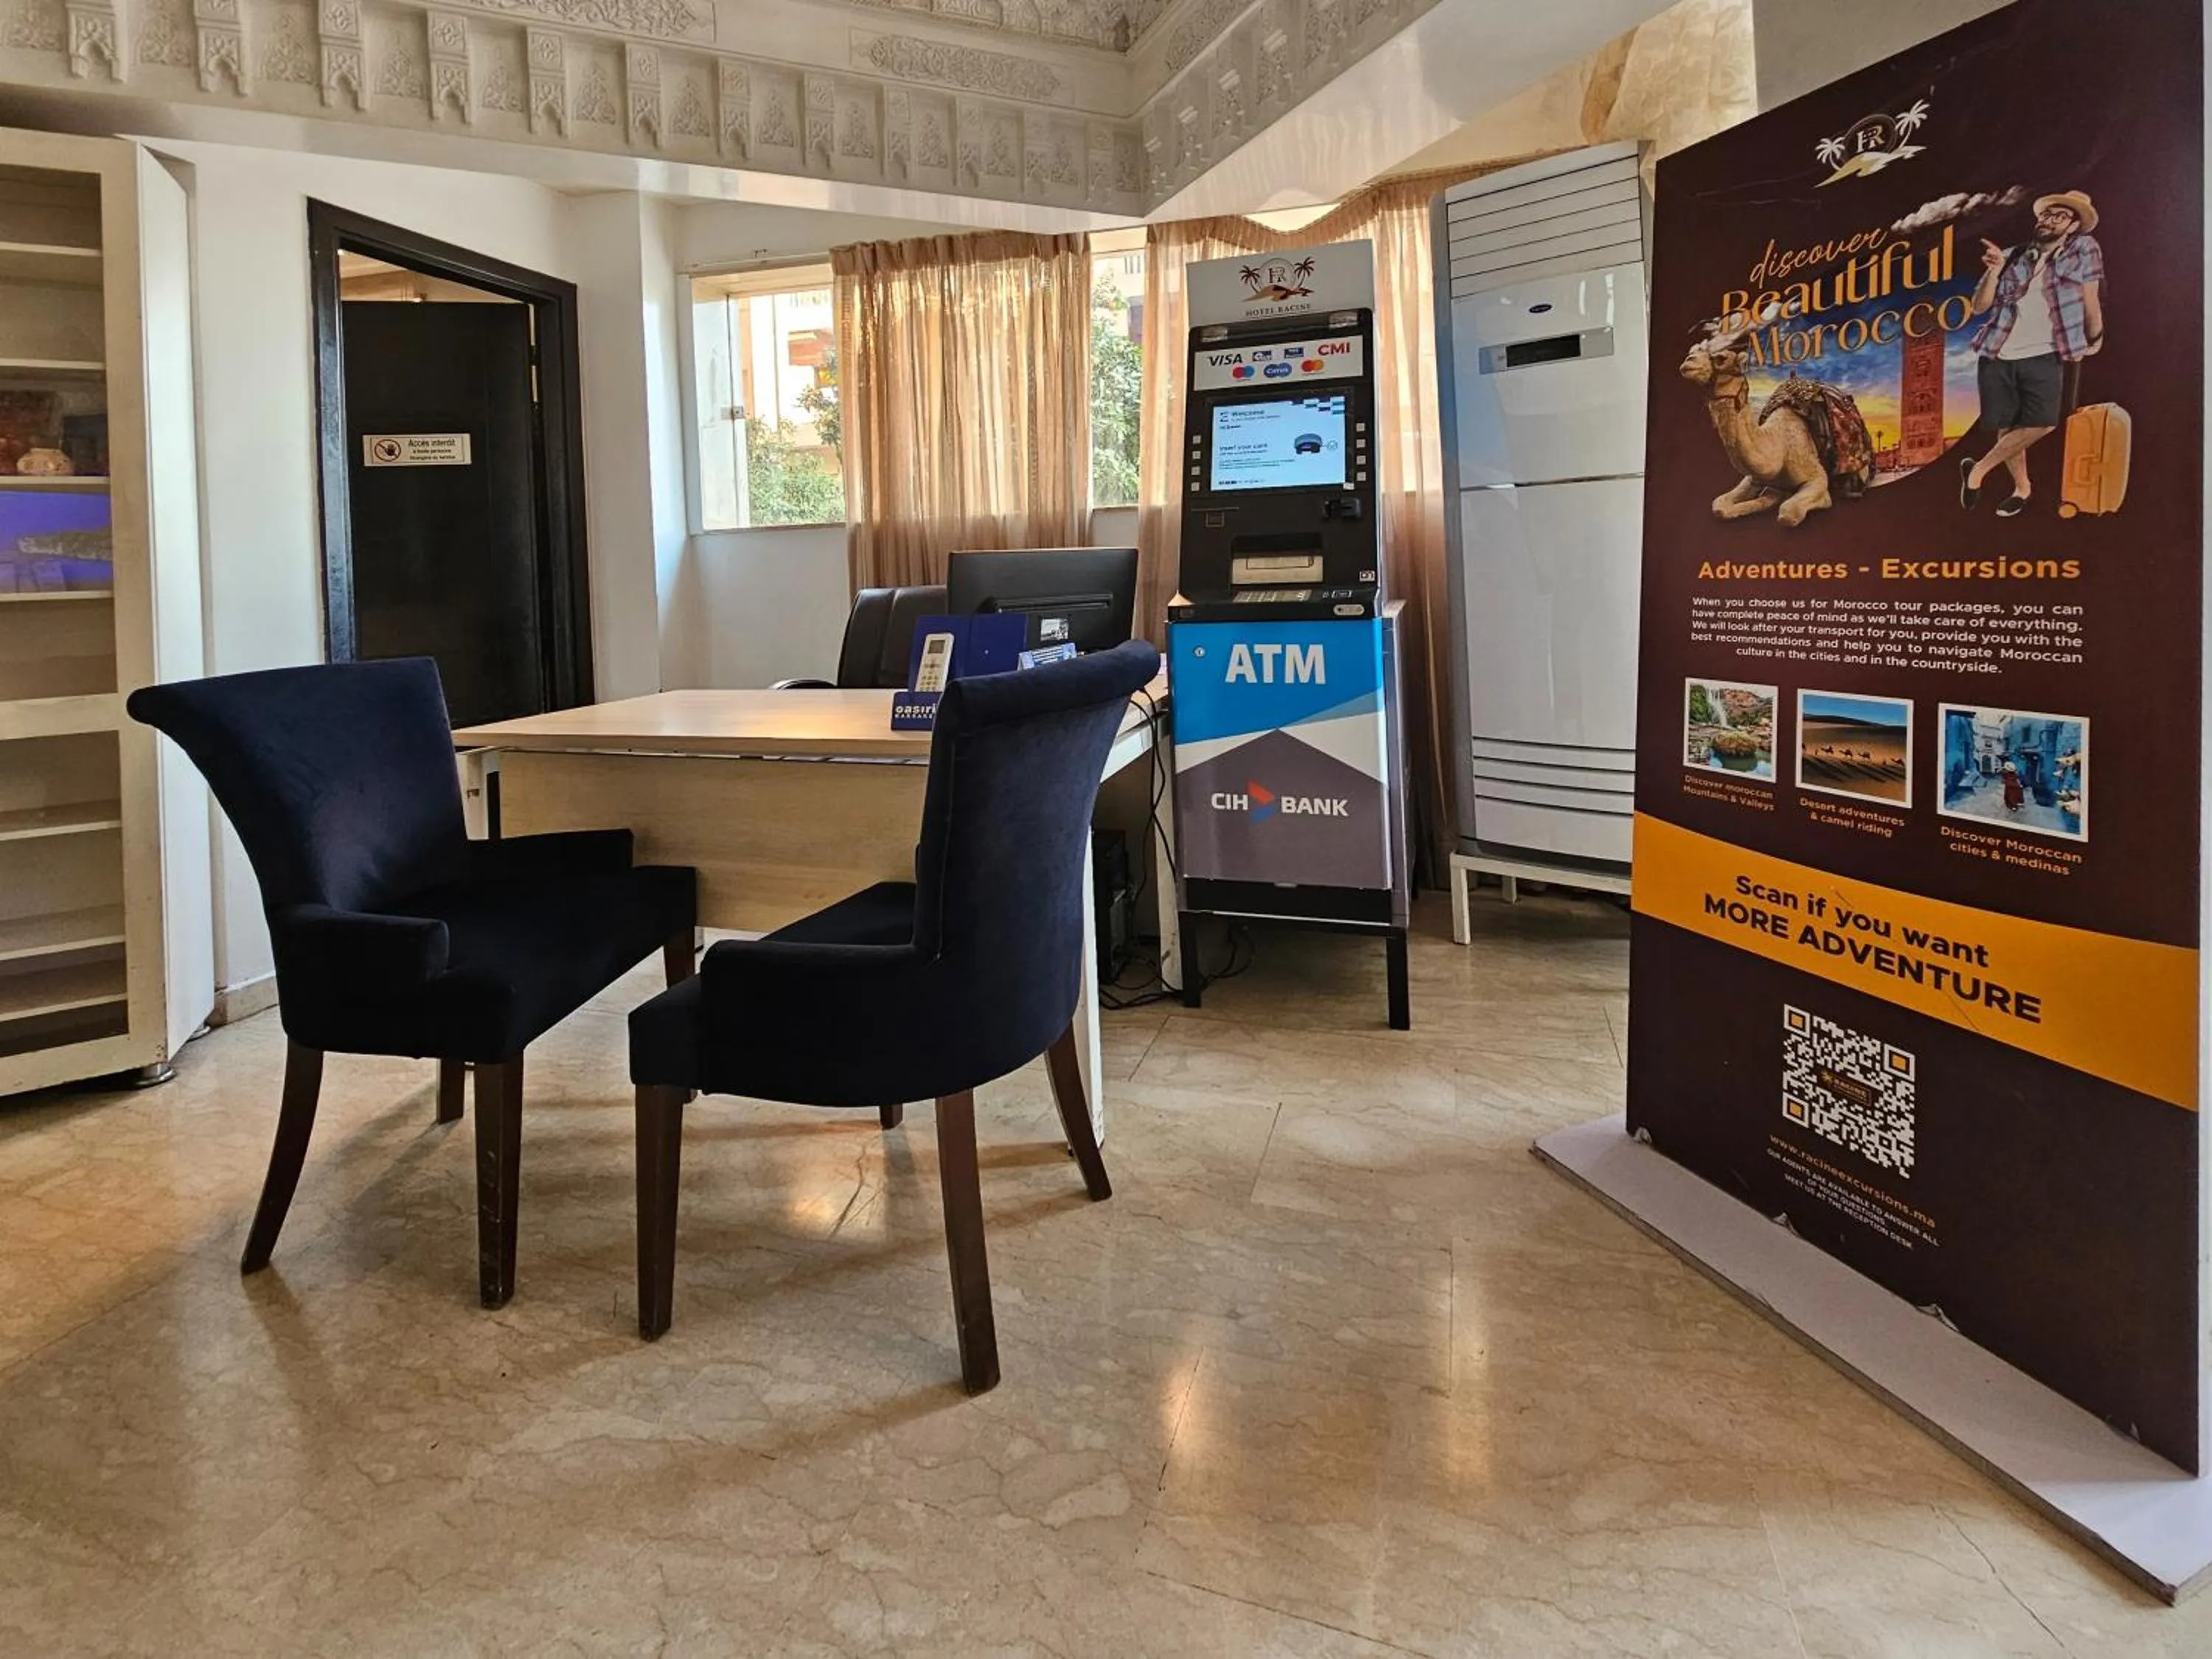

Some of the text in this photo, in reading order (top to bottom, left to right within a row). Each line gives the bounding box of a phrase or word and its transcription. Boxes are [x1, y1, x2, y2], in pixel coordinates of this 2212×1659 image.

[1749, 228, 1887, 288] discover
[1721, 225, 1955, 334] Beautiful
[1748, 295, 1974, 368] Morocco
[1208, 353, 1243, 366] VISA
[1318, 342, 1350, 355] CMI
[1698, 560, 1848, 579] Adventures
[1882, 556, 2081, 579] Excursions
[1693, 597, 2083, 615] When you choose us for Morocco tour packages, you can
[1692, 609, 2083, 633] have complete peace of mind as we'll take care of everything.
[1692, 621, 2083, 647] We will look after your transport for you, provide you with the
[1691, 632, 2082, 663] best recommendations and help you to navigate Moroccan
[1736, 647, 2002, 673] culture in the cities and in the countryside.
[1225, 644, 1326, 685] ATM
[896, 703, 936, 714] oasiri
[1684, 775, 1773, 799] Discover moroccan
[1211, 793, 1349, 816] CIH BANK
[1740, 797, 1775, 811] Valleys
[1800, 797, 1905, 827] Desert adventures
[1810, 811, 1893, 838] & camel riding
[1940, 826, 2082, 863] Discover Moroccan
[1950, 841, 2070, 875] cities & medinas
[1736, 874, 1989, 968] Scan if you want
[1704, 893, 2041, 1023] MORE ADVENTURE
